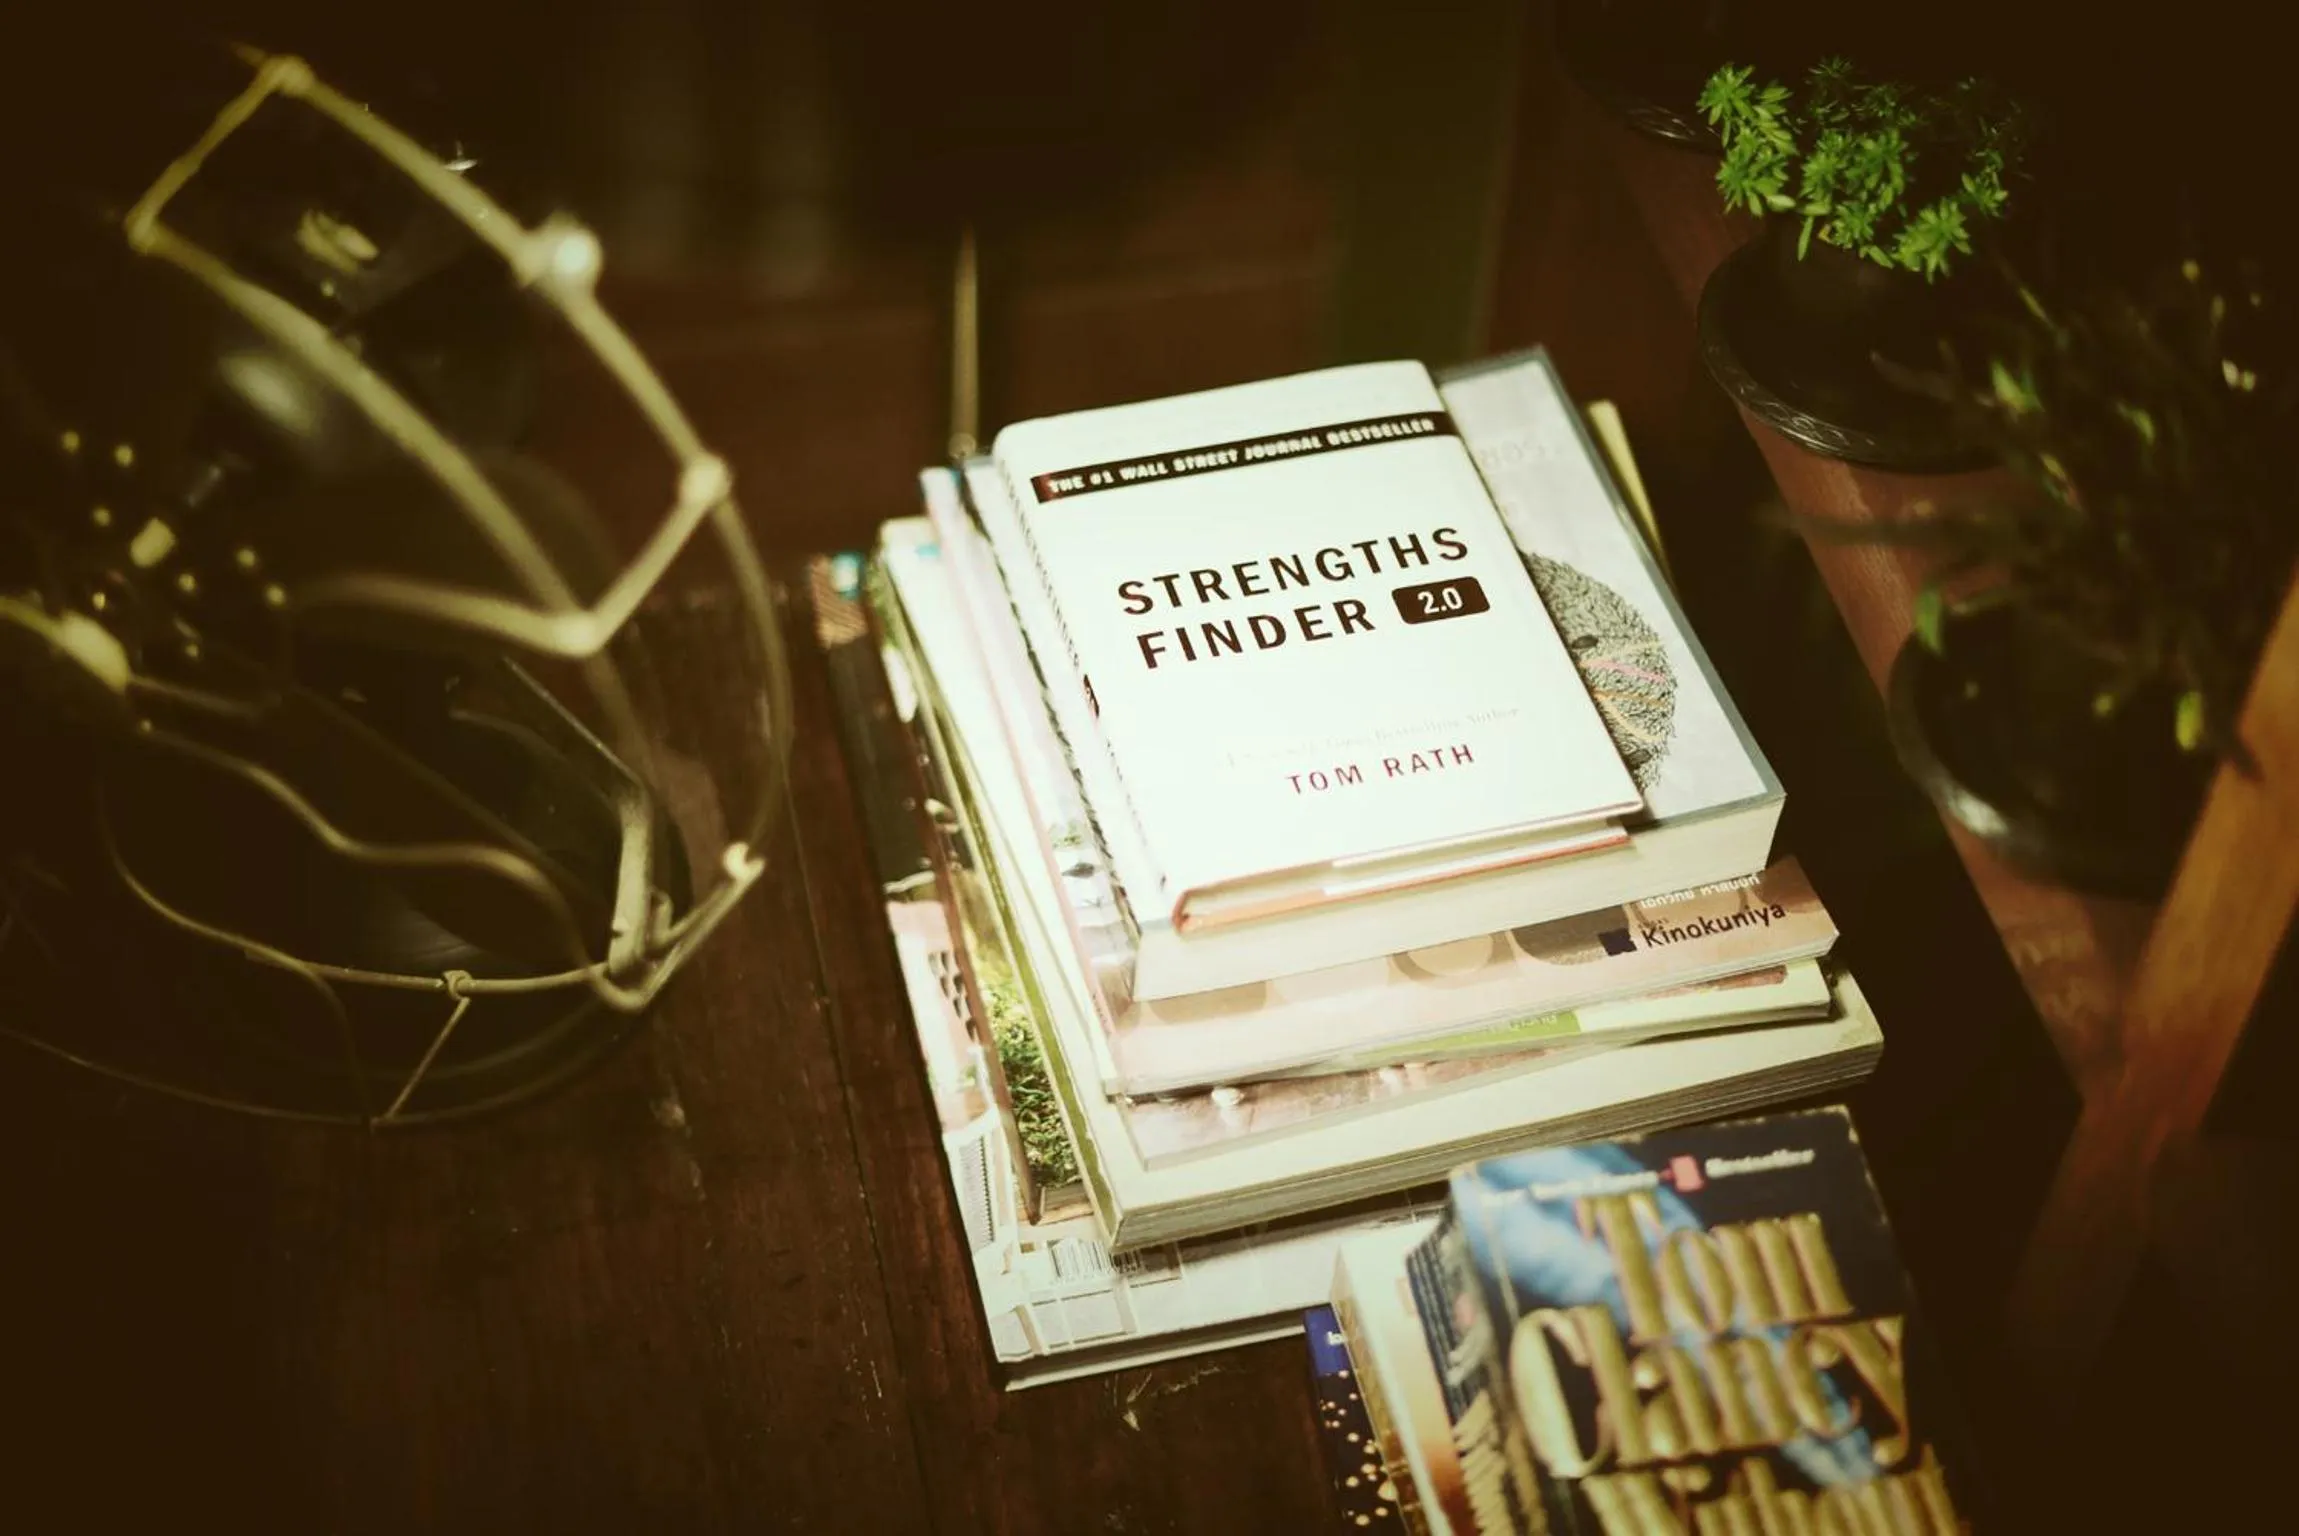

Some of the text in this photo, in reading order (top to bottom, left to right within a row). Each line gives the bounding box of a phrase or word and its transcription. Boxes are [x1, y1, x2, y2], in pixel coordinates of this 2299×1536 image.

[1047, 417, 1435, 493] THE #1 WALL STREET JOURNAL BESTSELLER
[1117, 527, 1468, 615] STRENGTHS
[1136, 587, 1464, 669] FINDER 2.0
[1286, 764, 1364, 795] TOM
[1382, 744, 1475, 778] RATH
[1640, 903, 1786, 949] Kinokuniya
[1575, 1189, 1853, 1345] Tom
[1510, 1305, 1908, 1478] Clancy
